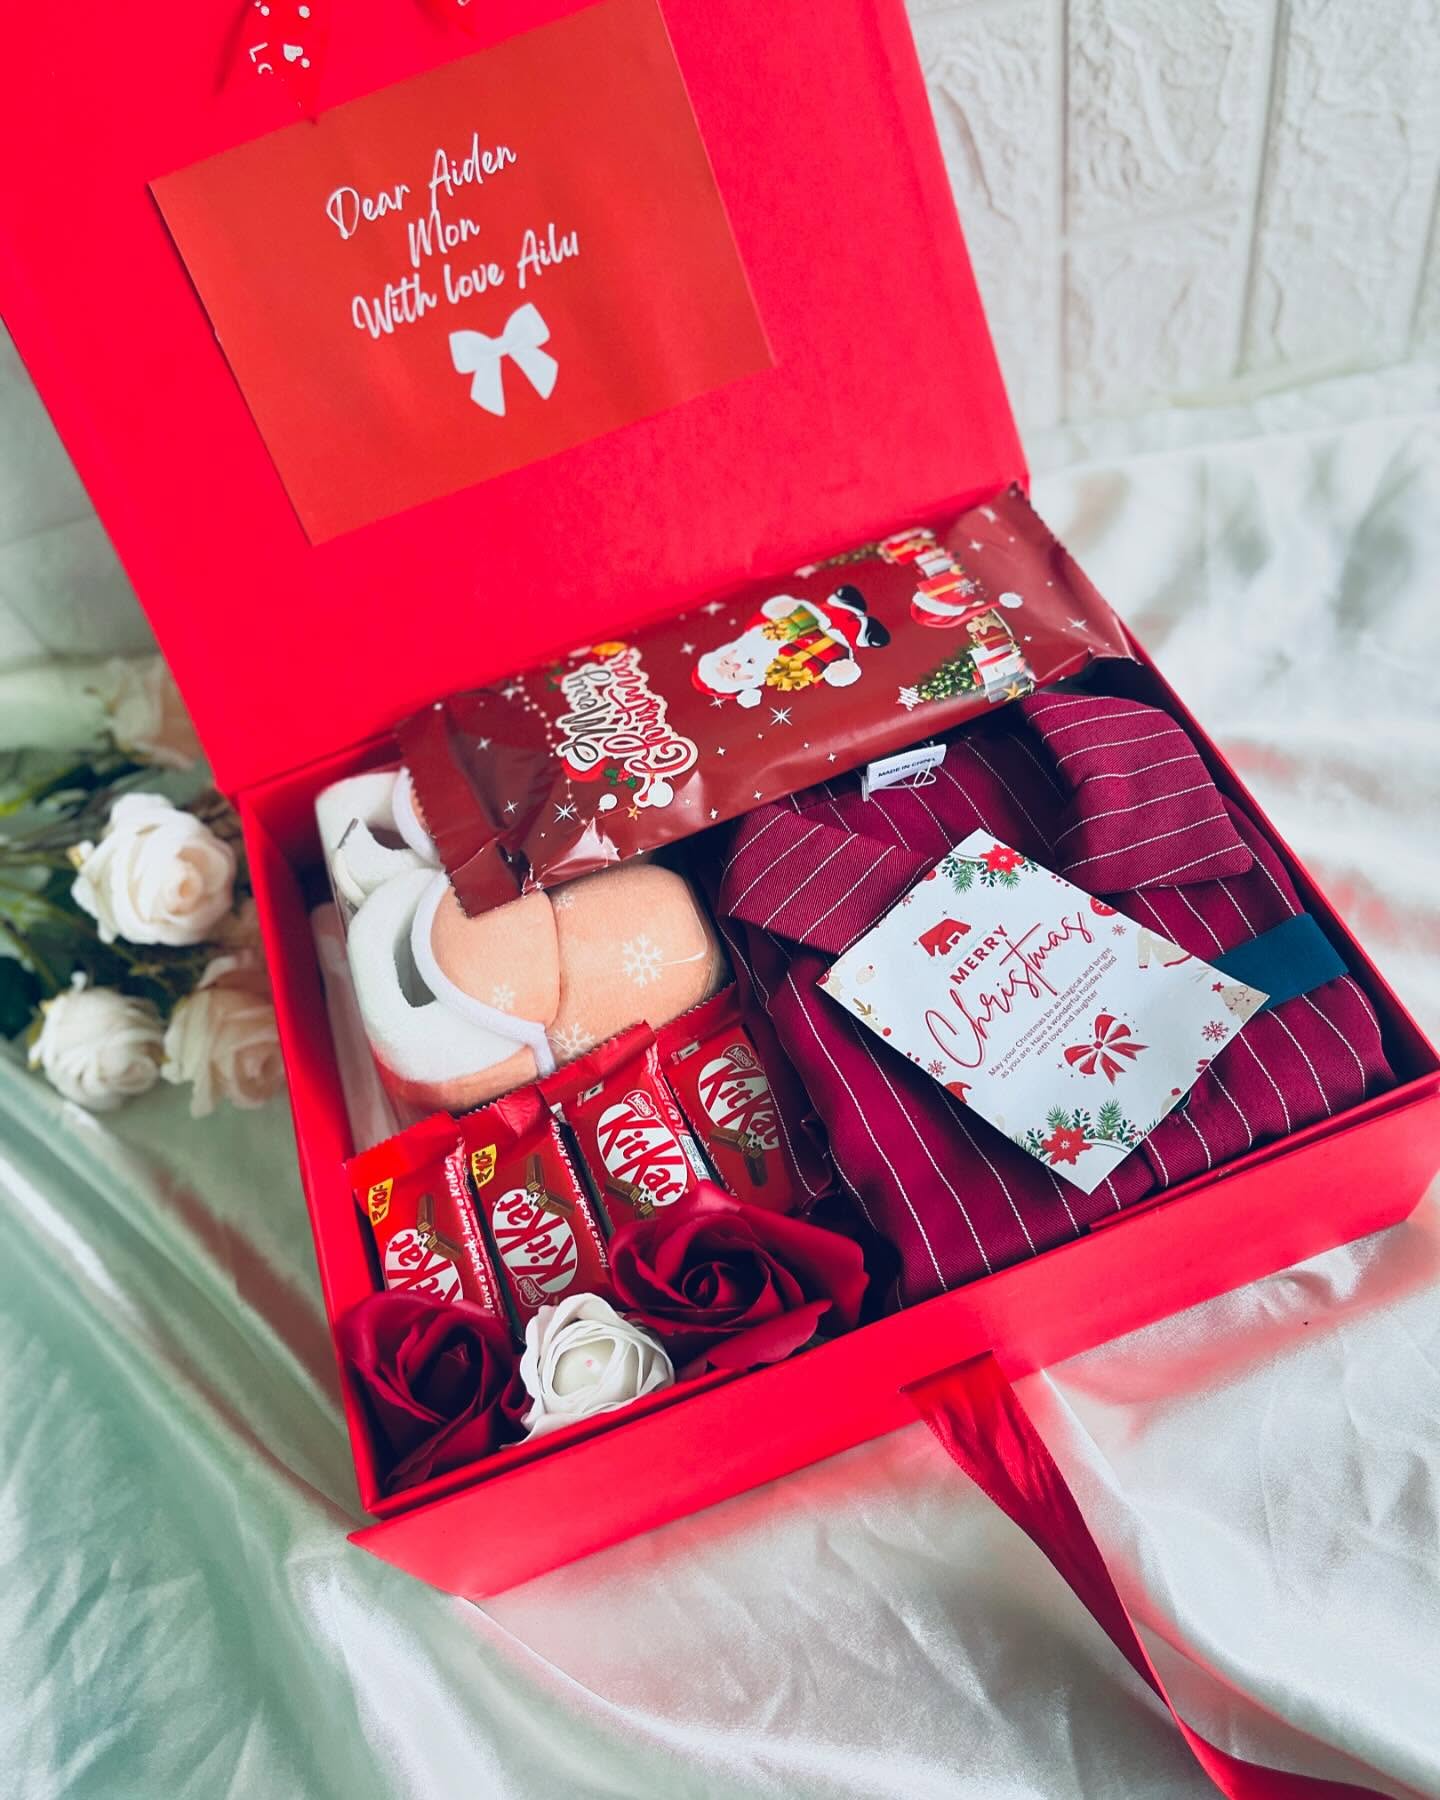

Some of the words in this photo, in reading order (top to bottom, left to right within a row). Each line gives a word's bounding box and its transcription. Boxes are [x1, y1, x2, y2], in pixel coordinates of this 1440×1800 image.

[326, 185, 411, 239] Dear
[429, 132, 517, 208] Aiden
[352, 273, 437, 339] With
[444, 263, 505, 304] love
[517, 223, 580, 289] Ailu
[408, 210, 480, 268] Mon
[561, 668, 617, 763] Merry
[603, 654, 691, 800] Christmas
[878, 767, 900, 777] MADE
[924, 912, 1093, 1068] Christmas
[950, 925, 1008, 985] MERRY
[987, 1061, 1004, 1077] May
[1002, 1047, 1017, 1064] your
[1015, 1017, 1047, 1048] Christmas
[1043, 1008, 1054, 1018] be
[1053, 1000, 1062, 1010] as
[1059, 976, 1084, 1002] magical
[1081, 964, 1095, 979] and
[1091, 947, 1113, 967] bright
[1000, 1070, 1010, 1079] as
[1007, 1057, 1021, 1073] you
[1029, 1029, 1048, 1047] Have
[1050, 994, 1081, 1026] wonderful
[1078, 971, 1103, 996] holiday
[1099, 954, 1118, 973] filled
[1036, 1041, 1050, 1056] with
[1047, 1027, 1063, 1042] love
[1061, 1014, 1075, 1029] and
[1071, 989, 1098, 1017] laughter
[700, 1062, 779, 1145] KitKat
[568, 1167, 582, 1193] have
[598, 1110, 684, 1201] KitKat
[459, 1207, 473, 1235] have
[495, 1193, 577, 1290] KitKat
[594, 1239, 609, 1268] Have
